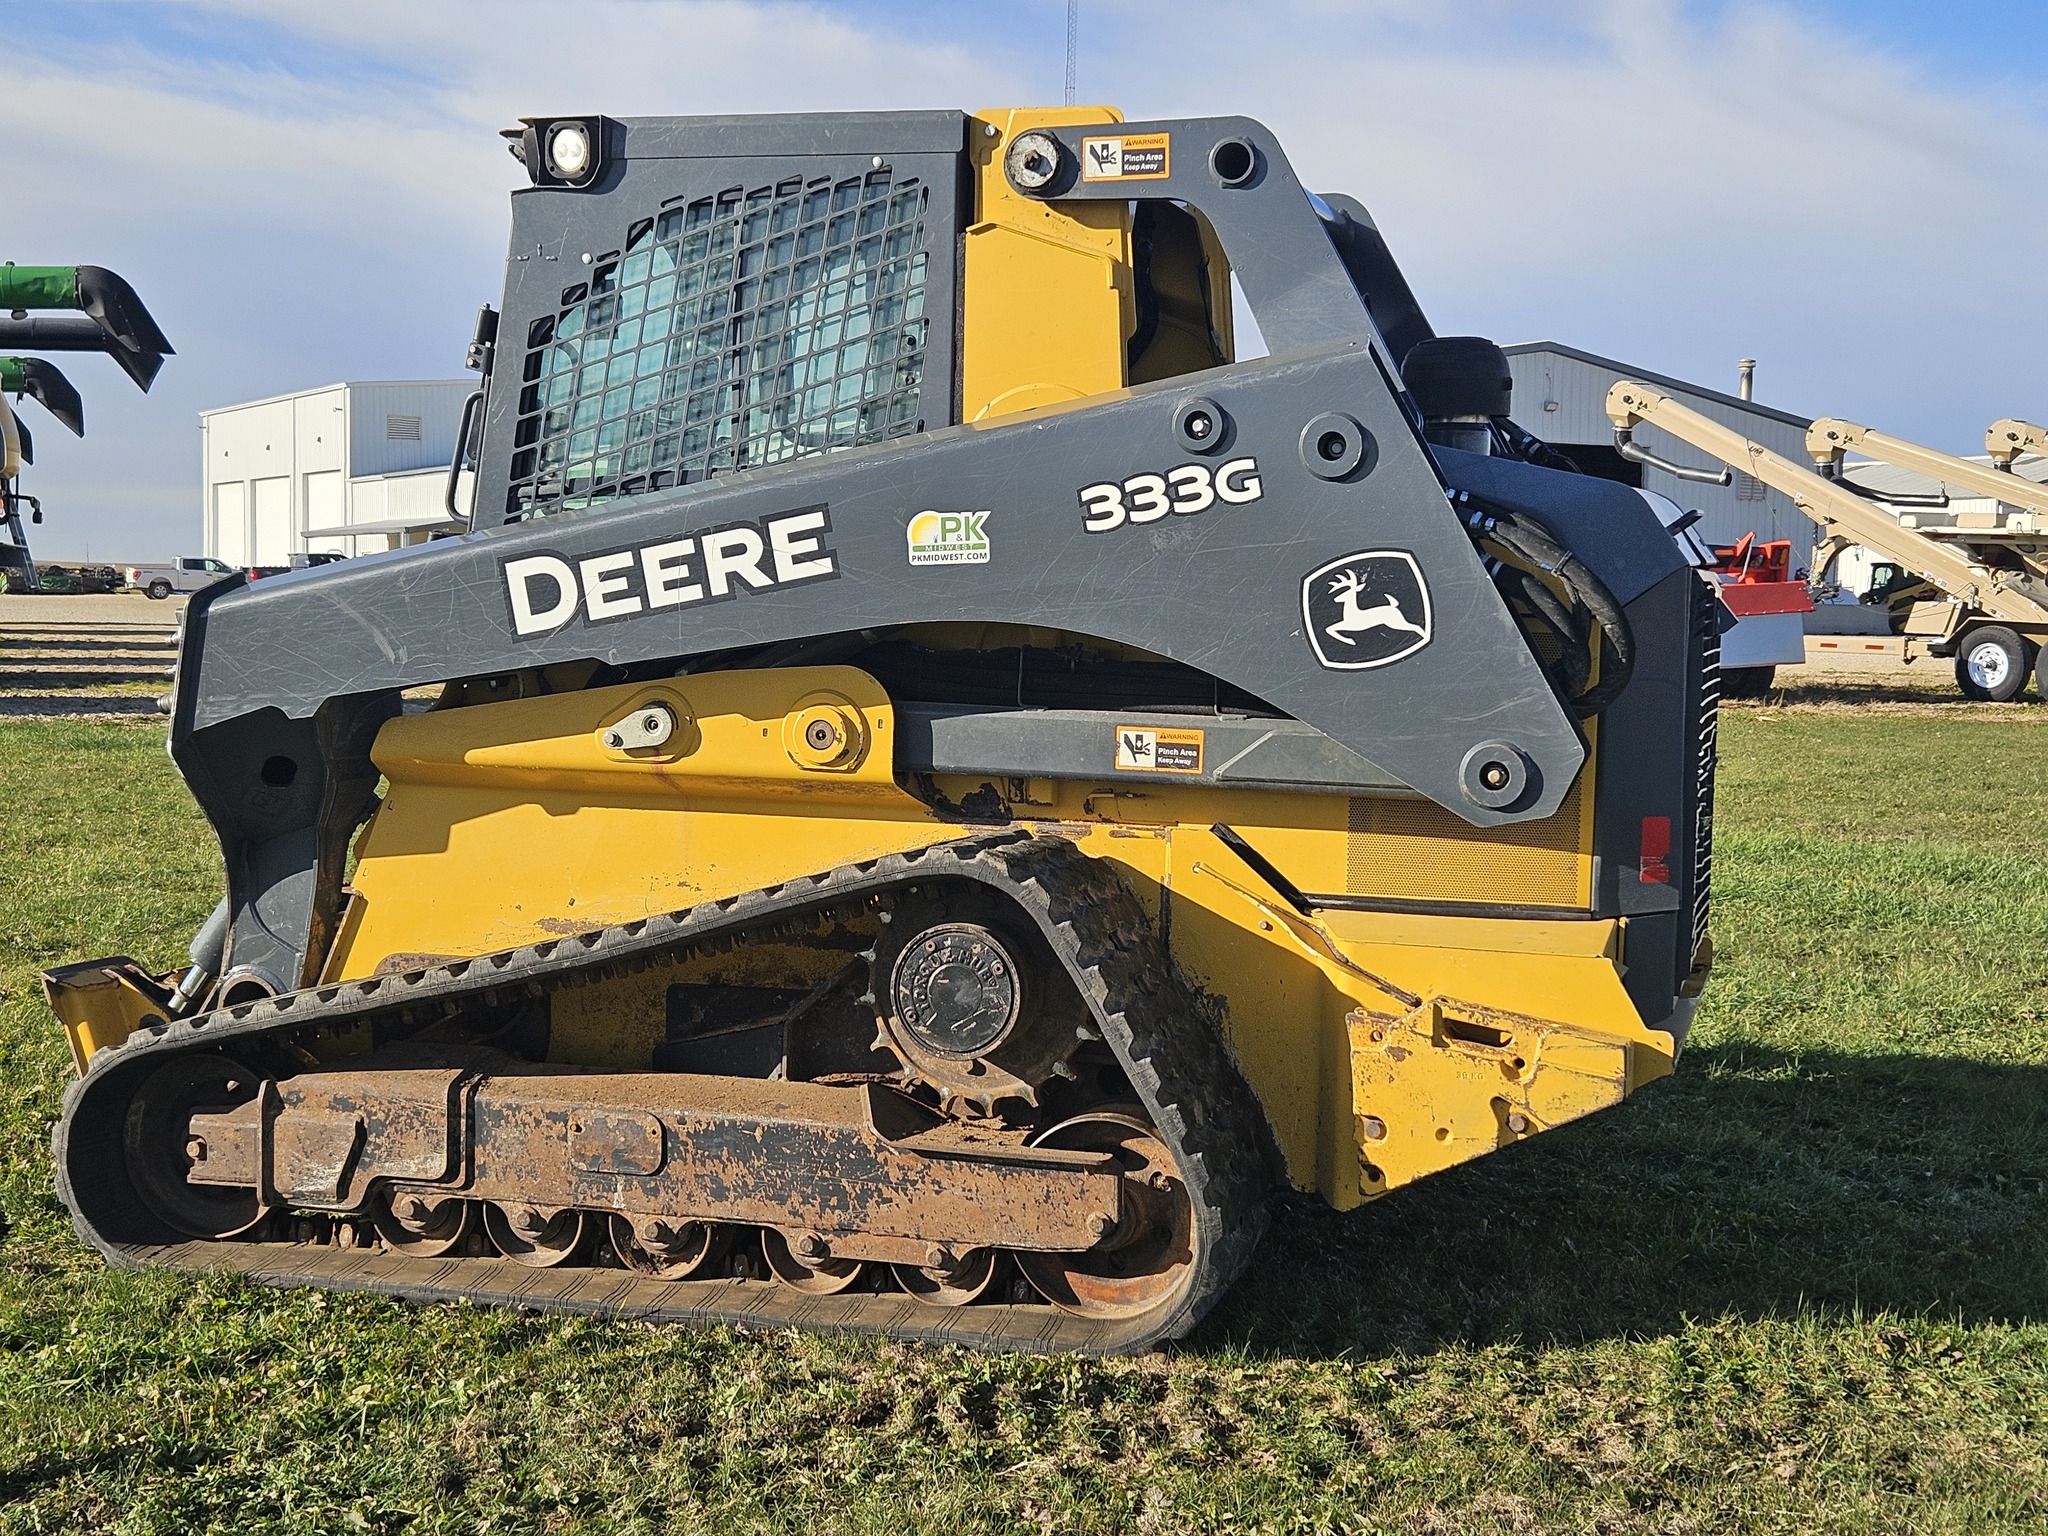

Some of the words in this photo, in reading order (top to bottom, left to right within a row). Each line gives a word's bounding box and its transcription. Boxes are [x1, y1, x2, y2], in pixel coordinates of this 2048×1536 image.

[1132, 138, 1164, 146] WARNING
[1124, 154, 1145, 162] Pinch
[1146, 153, 1163, 161] Area
[1124, 164, 1140, 172] Keep
[1141, 163, 1158, 171] Away
[1080, 458, 1262, 532] 333G
[940, 515, 985, 542] P&K
[925, 543, 974, 552] MIDWEST
[911, 552, 988, 562] PKMIDWEST.COM
[504, 511, 834, 635] DEERE
[1166, 733, 1199, 741] WARNING
[1158, 748, 1179, 756] Pinch
[1179, 749, 1197, 757] Area
[1157, 757, 1174, 765] Keep
[1174, 757, 1192, 766] Away
